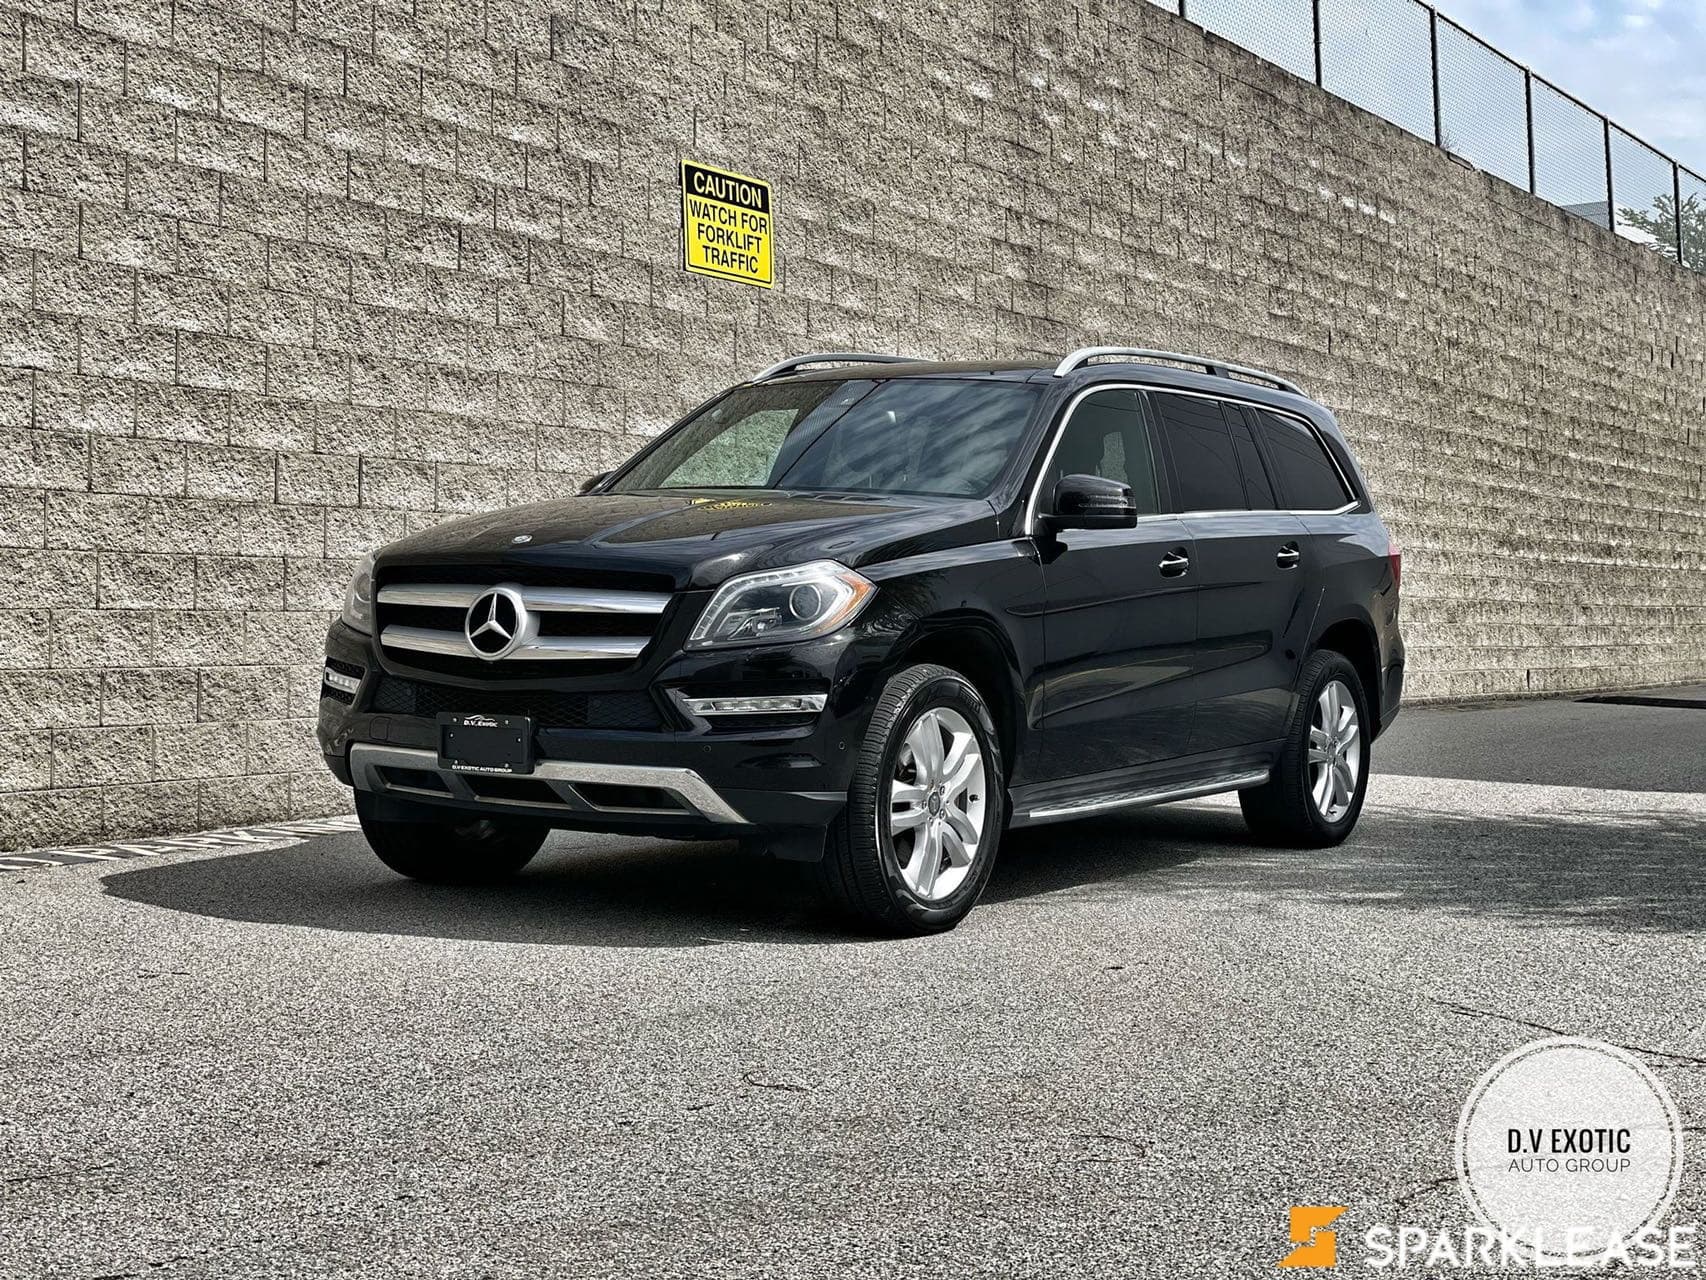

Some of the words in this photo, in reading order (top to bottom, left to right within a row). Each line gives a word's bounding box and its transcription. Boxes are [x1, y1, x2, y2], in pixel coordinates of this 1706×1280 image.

[693, 171, 762, 209] CAUTION
[689, 199, 737, 228] WATCH
[741, 212, 768, 235] FOR
[697, 222, 762, 254] FORKLIFT
[702, 245, 759, 274] TRAFFIC
